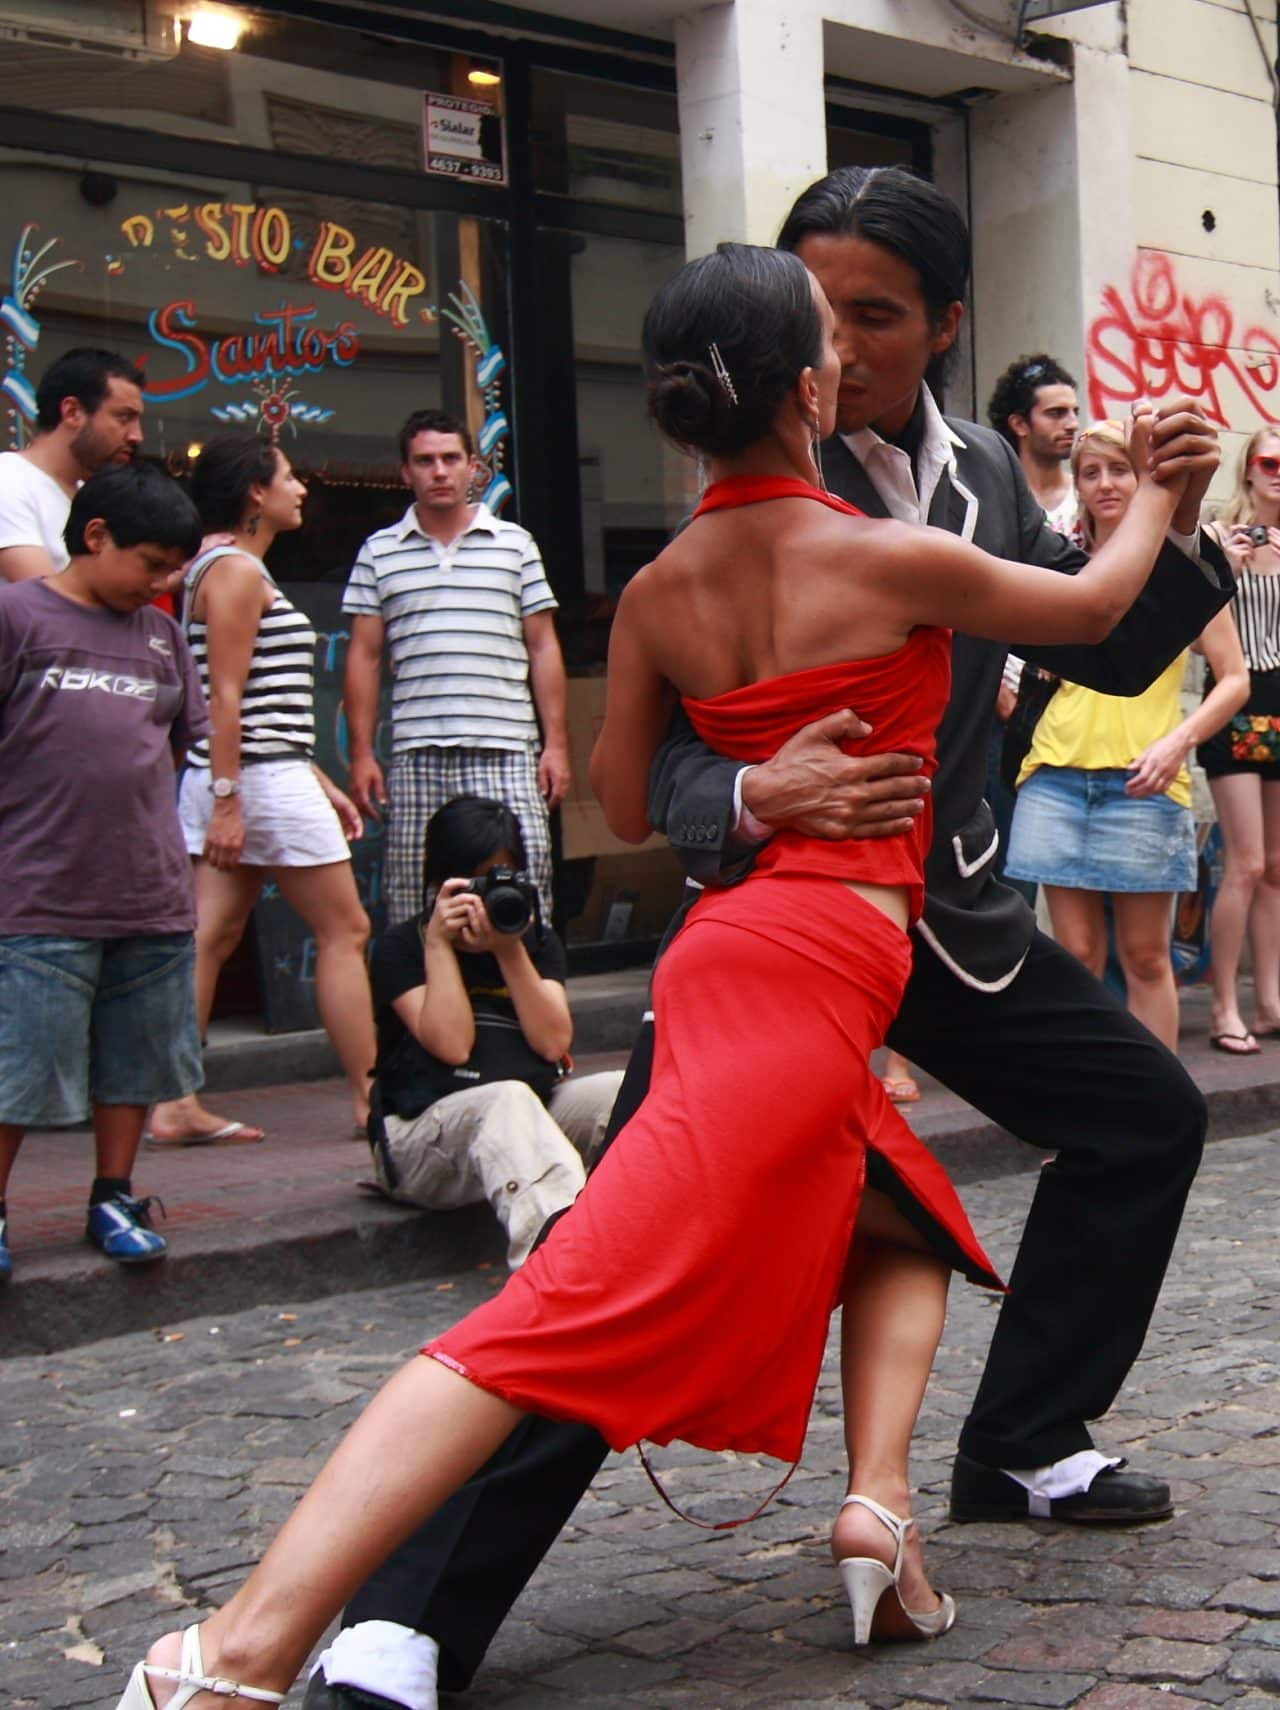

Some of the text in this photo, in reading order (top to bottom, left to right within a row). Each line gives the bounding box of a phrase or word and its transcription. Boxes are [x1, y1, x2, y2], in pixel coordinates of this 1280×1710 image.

[428, 96, 497, 116] PROTEGID
[306, 221, 427, 329] BAR
[133, 299, 361, 402] Santos
